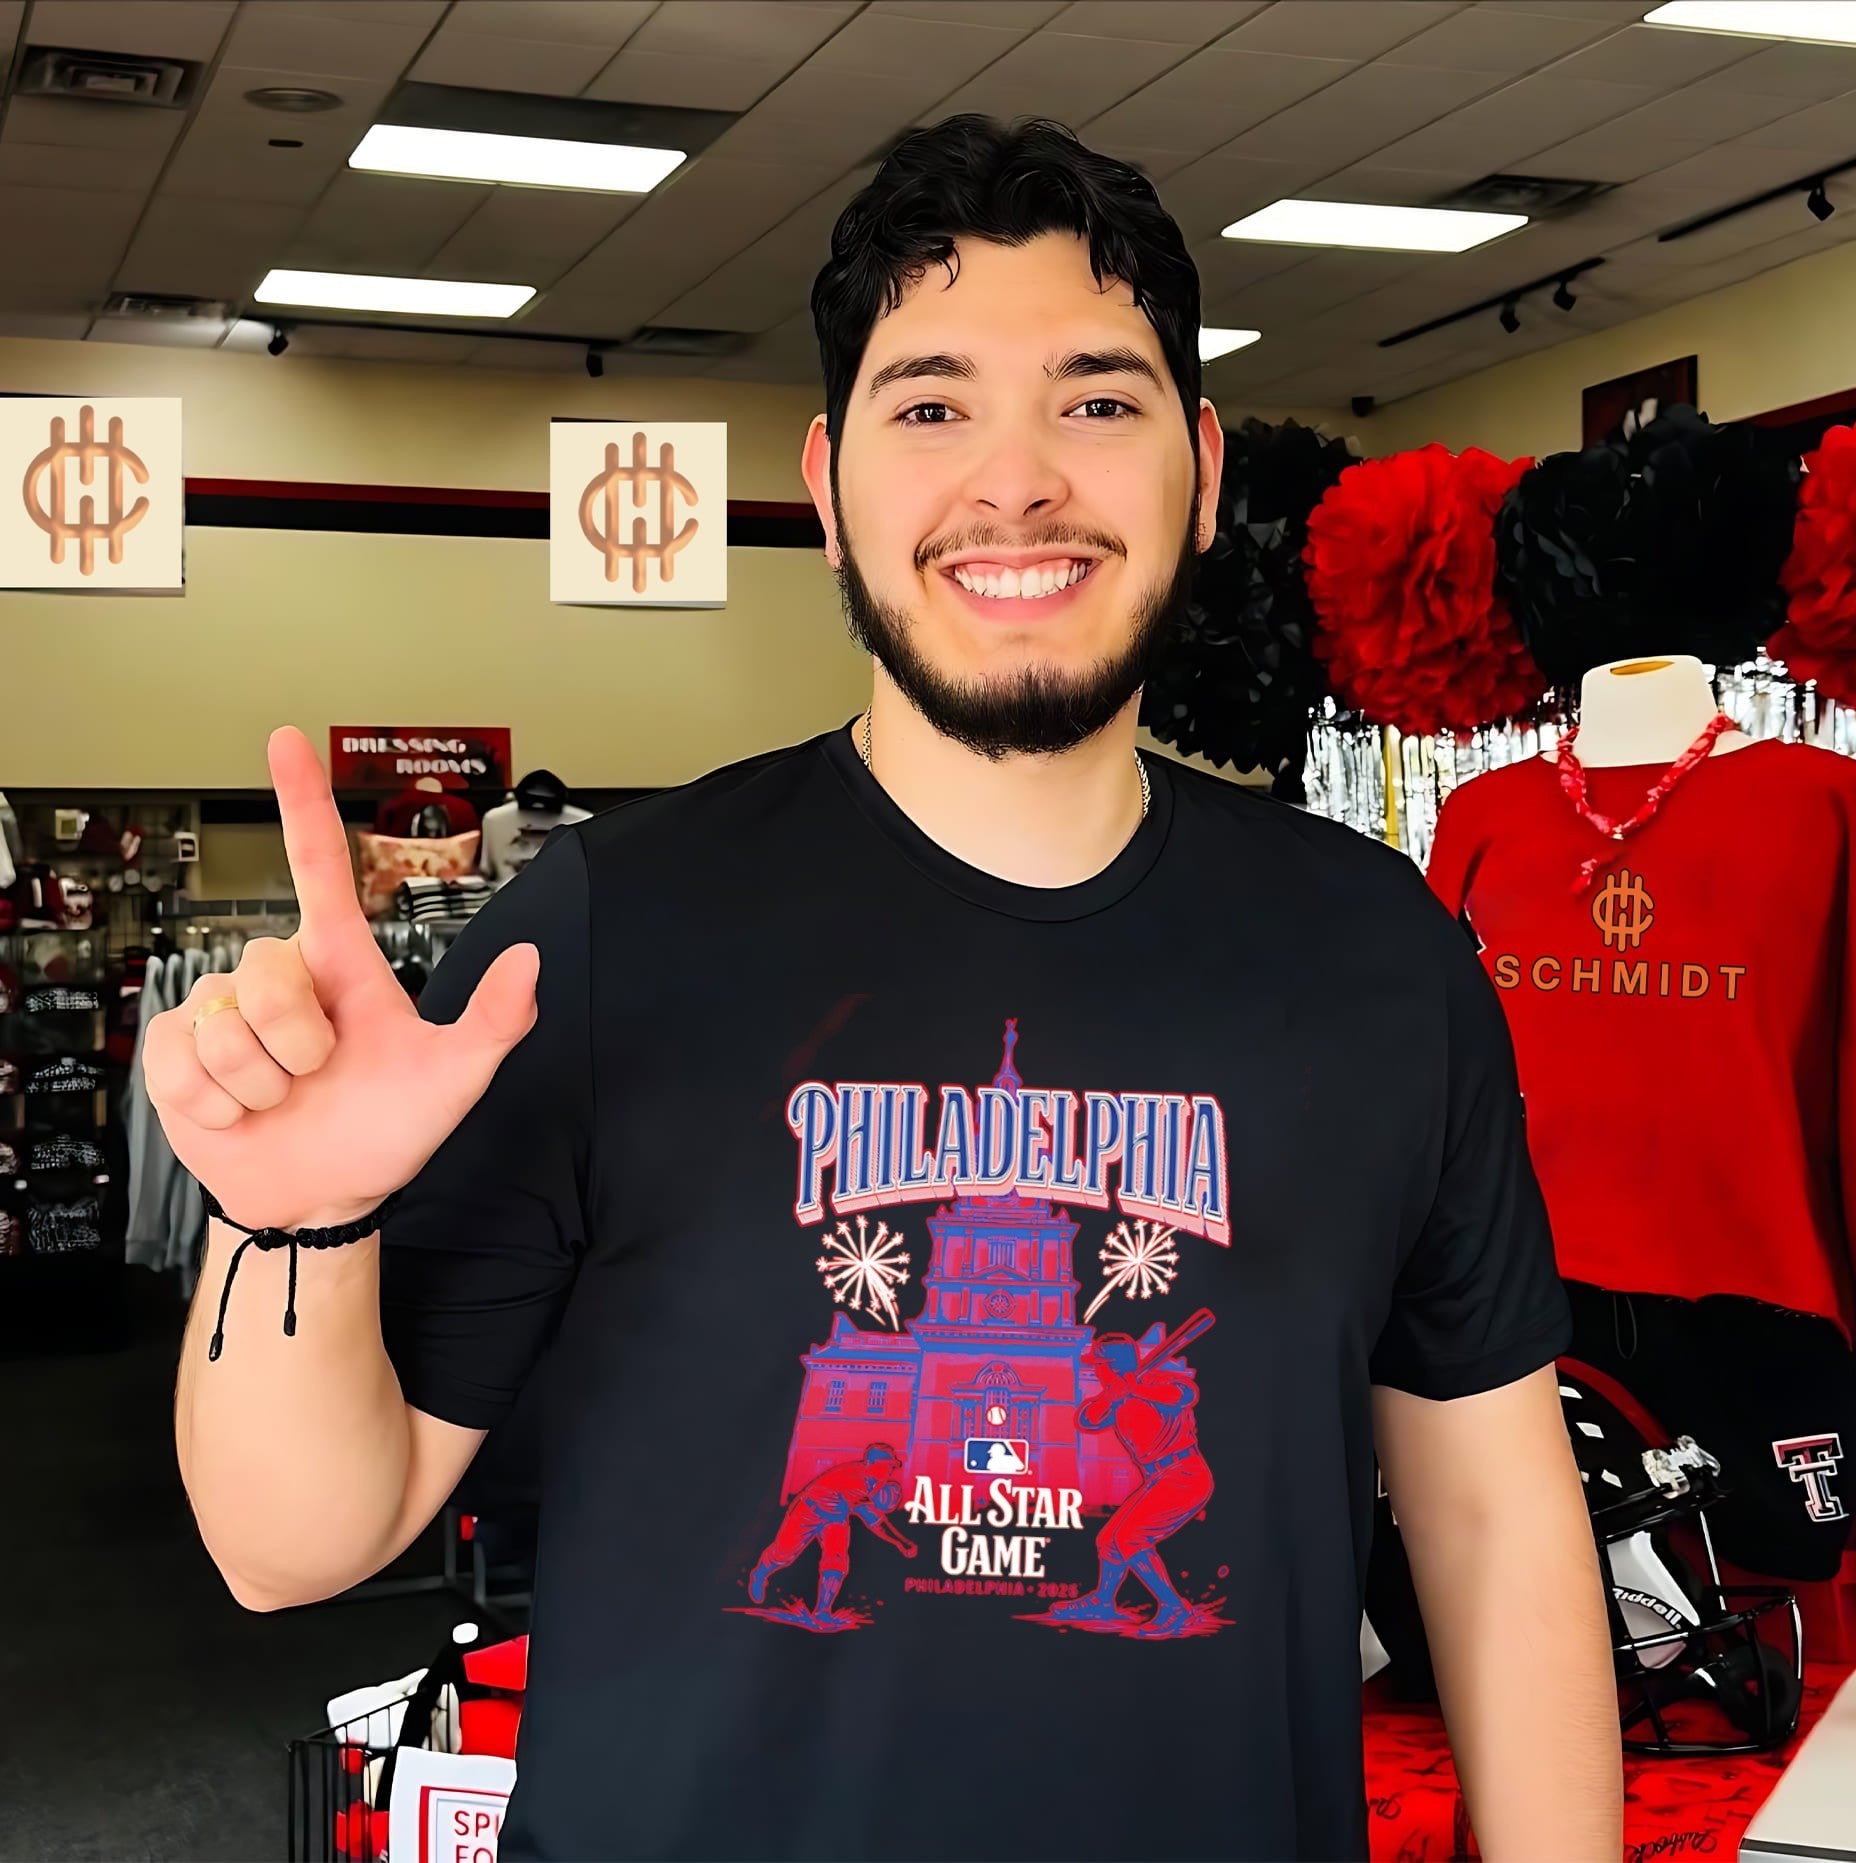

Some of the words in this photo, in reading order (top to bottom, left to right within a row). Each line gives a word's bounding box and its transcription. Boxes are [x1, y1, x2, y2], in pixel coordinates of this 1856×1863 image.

[396, 759, 487, 775] ROOMS
[1494, 953, 1746, 1000] SCHMIDT
[786, 1081, 1231, 1247] PHILADELPHIA
[904, 1475, 981, 1526] ALL
[987, 1478, 1084, 1530] STAR
[941, 1526, 1046, 1578] GAME
[905, 1577, 1025, 1597] PHILADELPHIA
